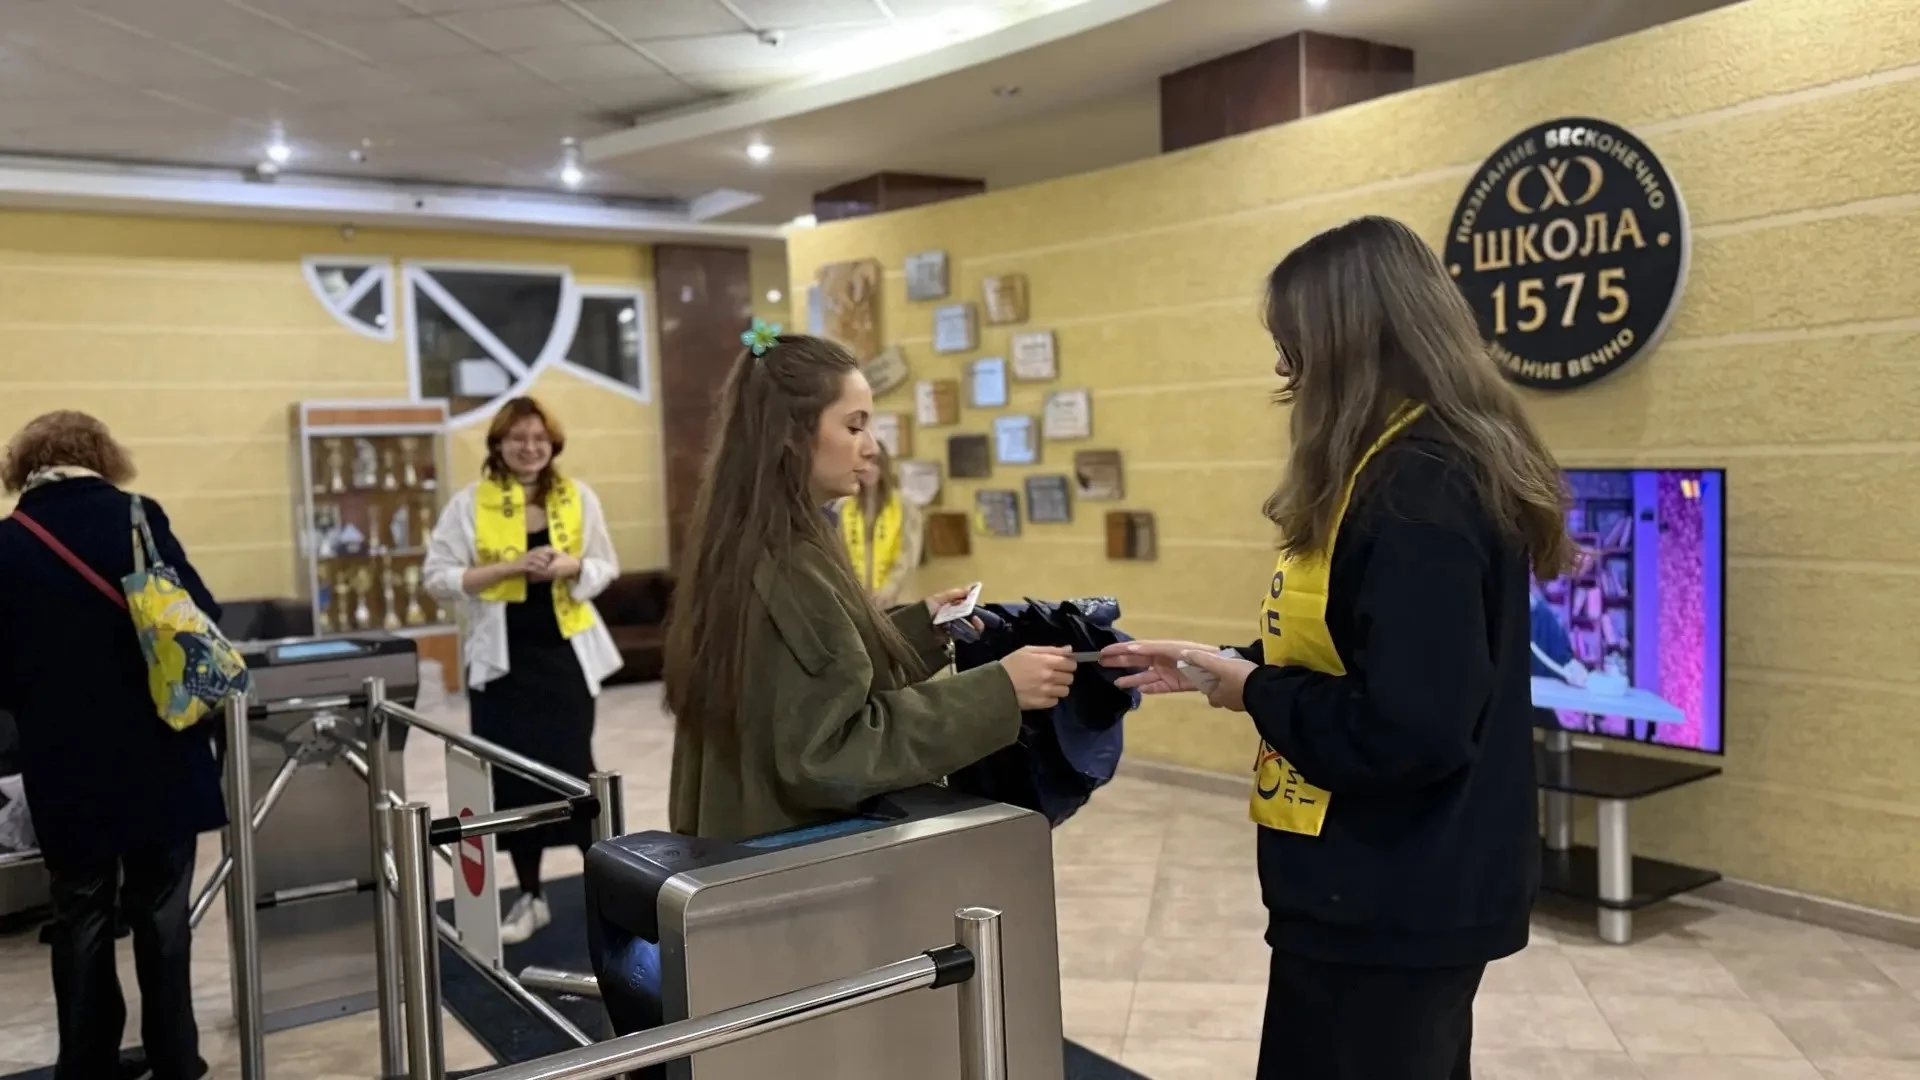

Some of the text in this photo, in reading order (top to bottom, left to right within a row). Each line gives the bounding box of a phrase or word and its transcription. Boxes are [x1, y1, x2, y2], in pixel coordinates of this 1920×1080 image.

[1456, 127, 1665, 243] ПОЗНАНИЕ БЕСКОНЕЧНО
[1473, 207, 1646, 271] ШКОЛА
[1491, 267, 1629, 335] 1575
[1567, 328, 1634, 378] ВЕЧНО
